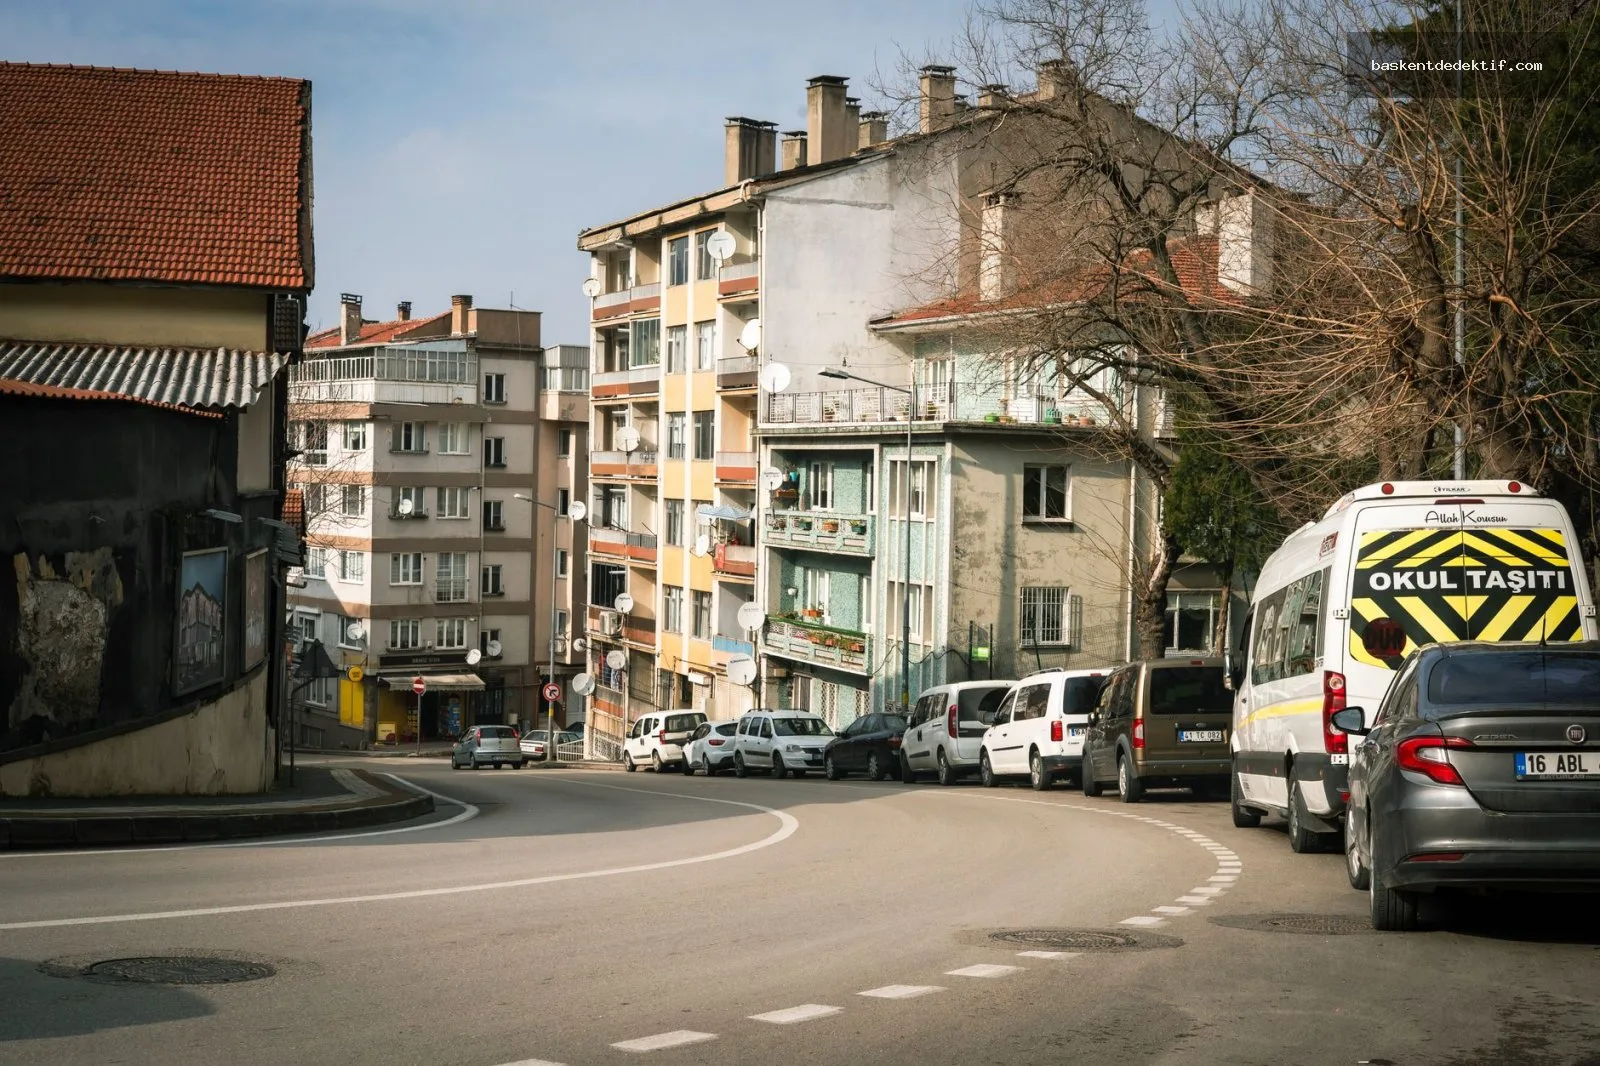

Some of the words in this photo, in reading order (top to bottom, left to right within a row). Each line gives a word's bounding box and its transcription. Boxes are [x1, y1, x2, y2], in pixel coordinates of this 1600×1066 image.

[1425, 510, 1459, 523] Allah
[1461, 510, 1508, 523] Korusun
[1369, 571, 1458, 590] OKUL
[1466, 570, 1566, 593] TAŞITI
[1528, 754, 1546, 773] 16
[1556, 754, 1588, 773] ABL
